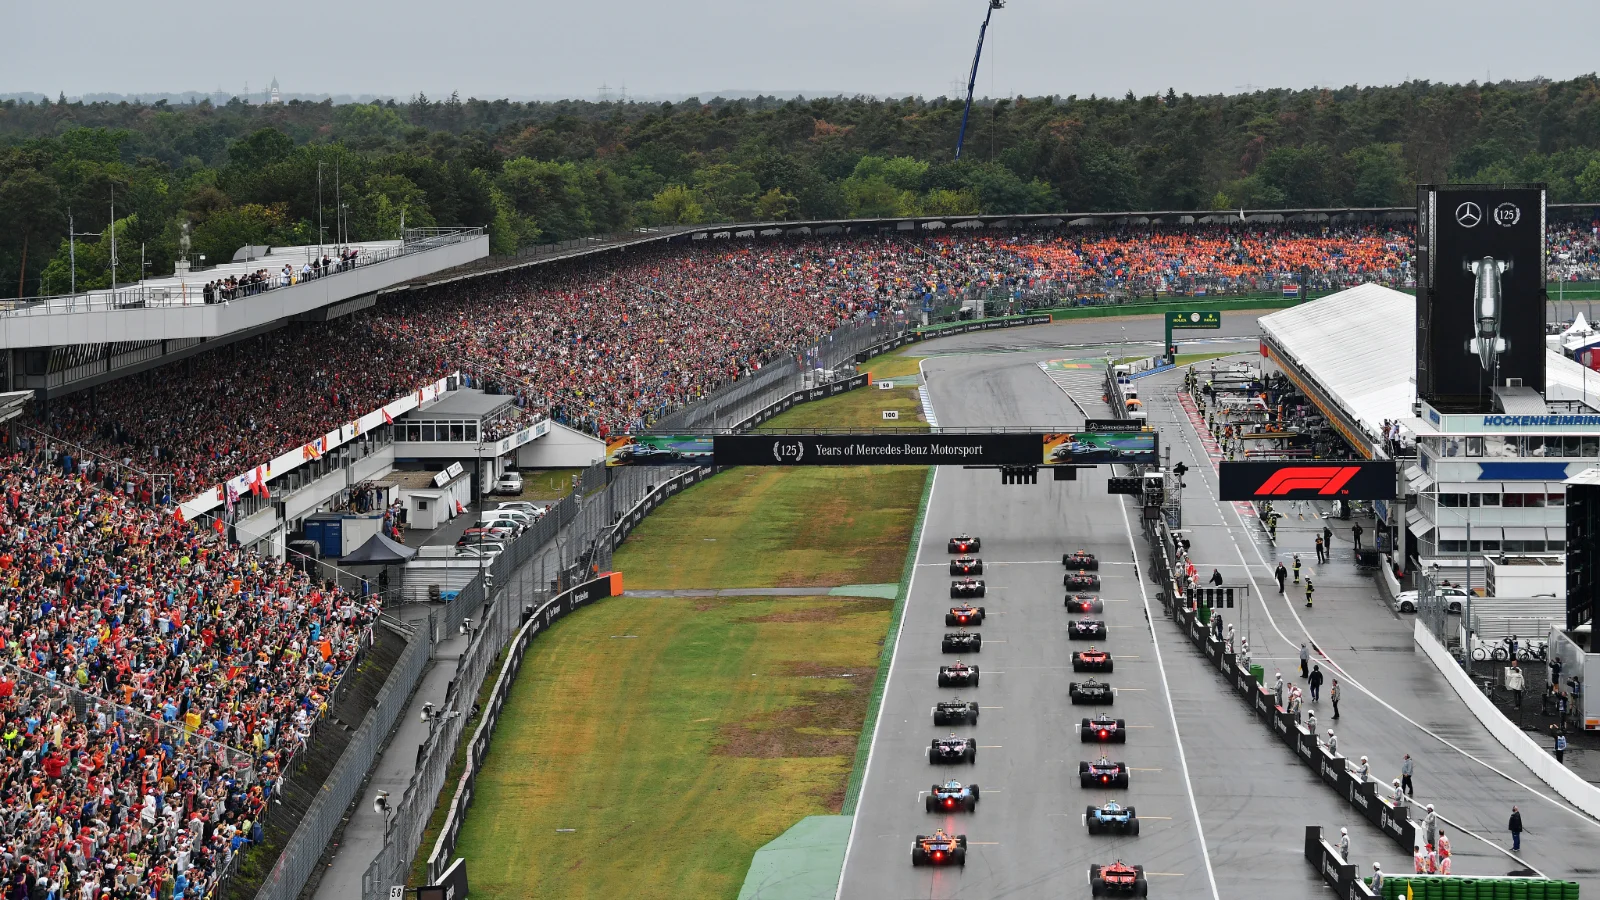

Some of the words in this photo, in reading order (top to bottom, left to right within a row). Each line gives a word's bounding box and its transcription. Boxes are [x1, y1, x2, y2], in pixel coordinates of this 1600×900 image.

[1500, 210, 1514, 220] 125
[1484, 415, 1600, 426] HOCKENHEIMRIN
[781, 445, 797, 456] 125
[816, 444, 842, 456] Years
[844, 444, 855, 455] of
[856, 444, 928, 455] Mercedes-Benz
[930, 443, 983, 457] Motorsport
[1254, 466, 1362, 495] F1
[391, 888, 402, 898] 58
